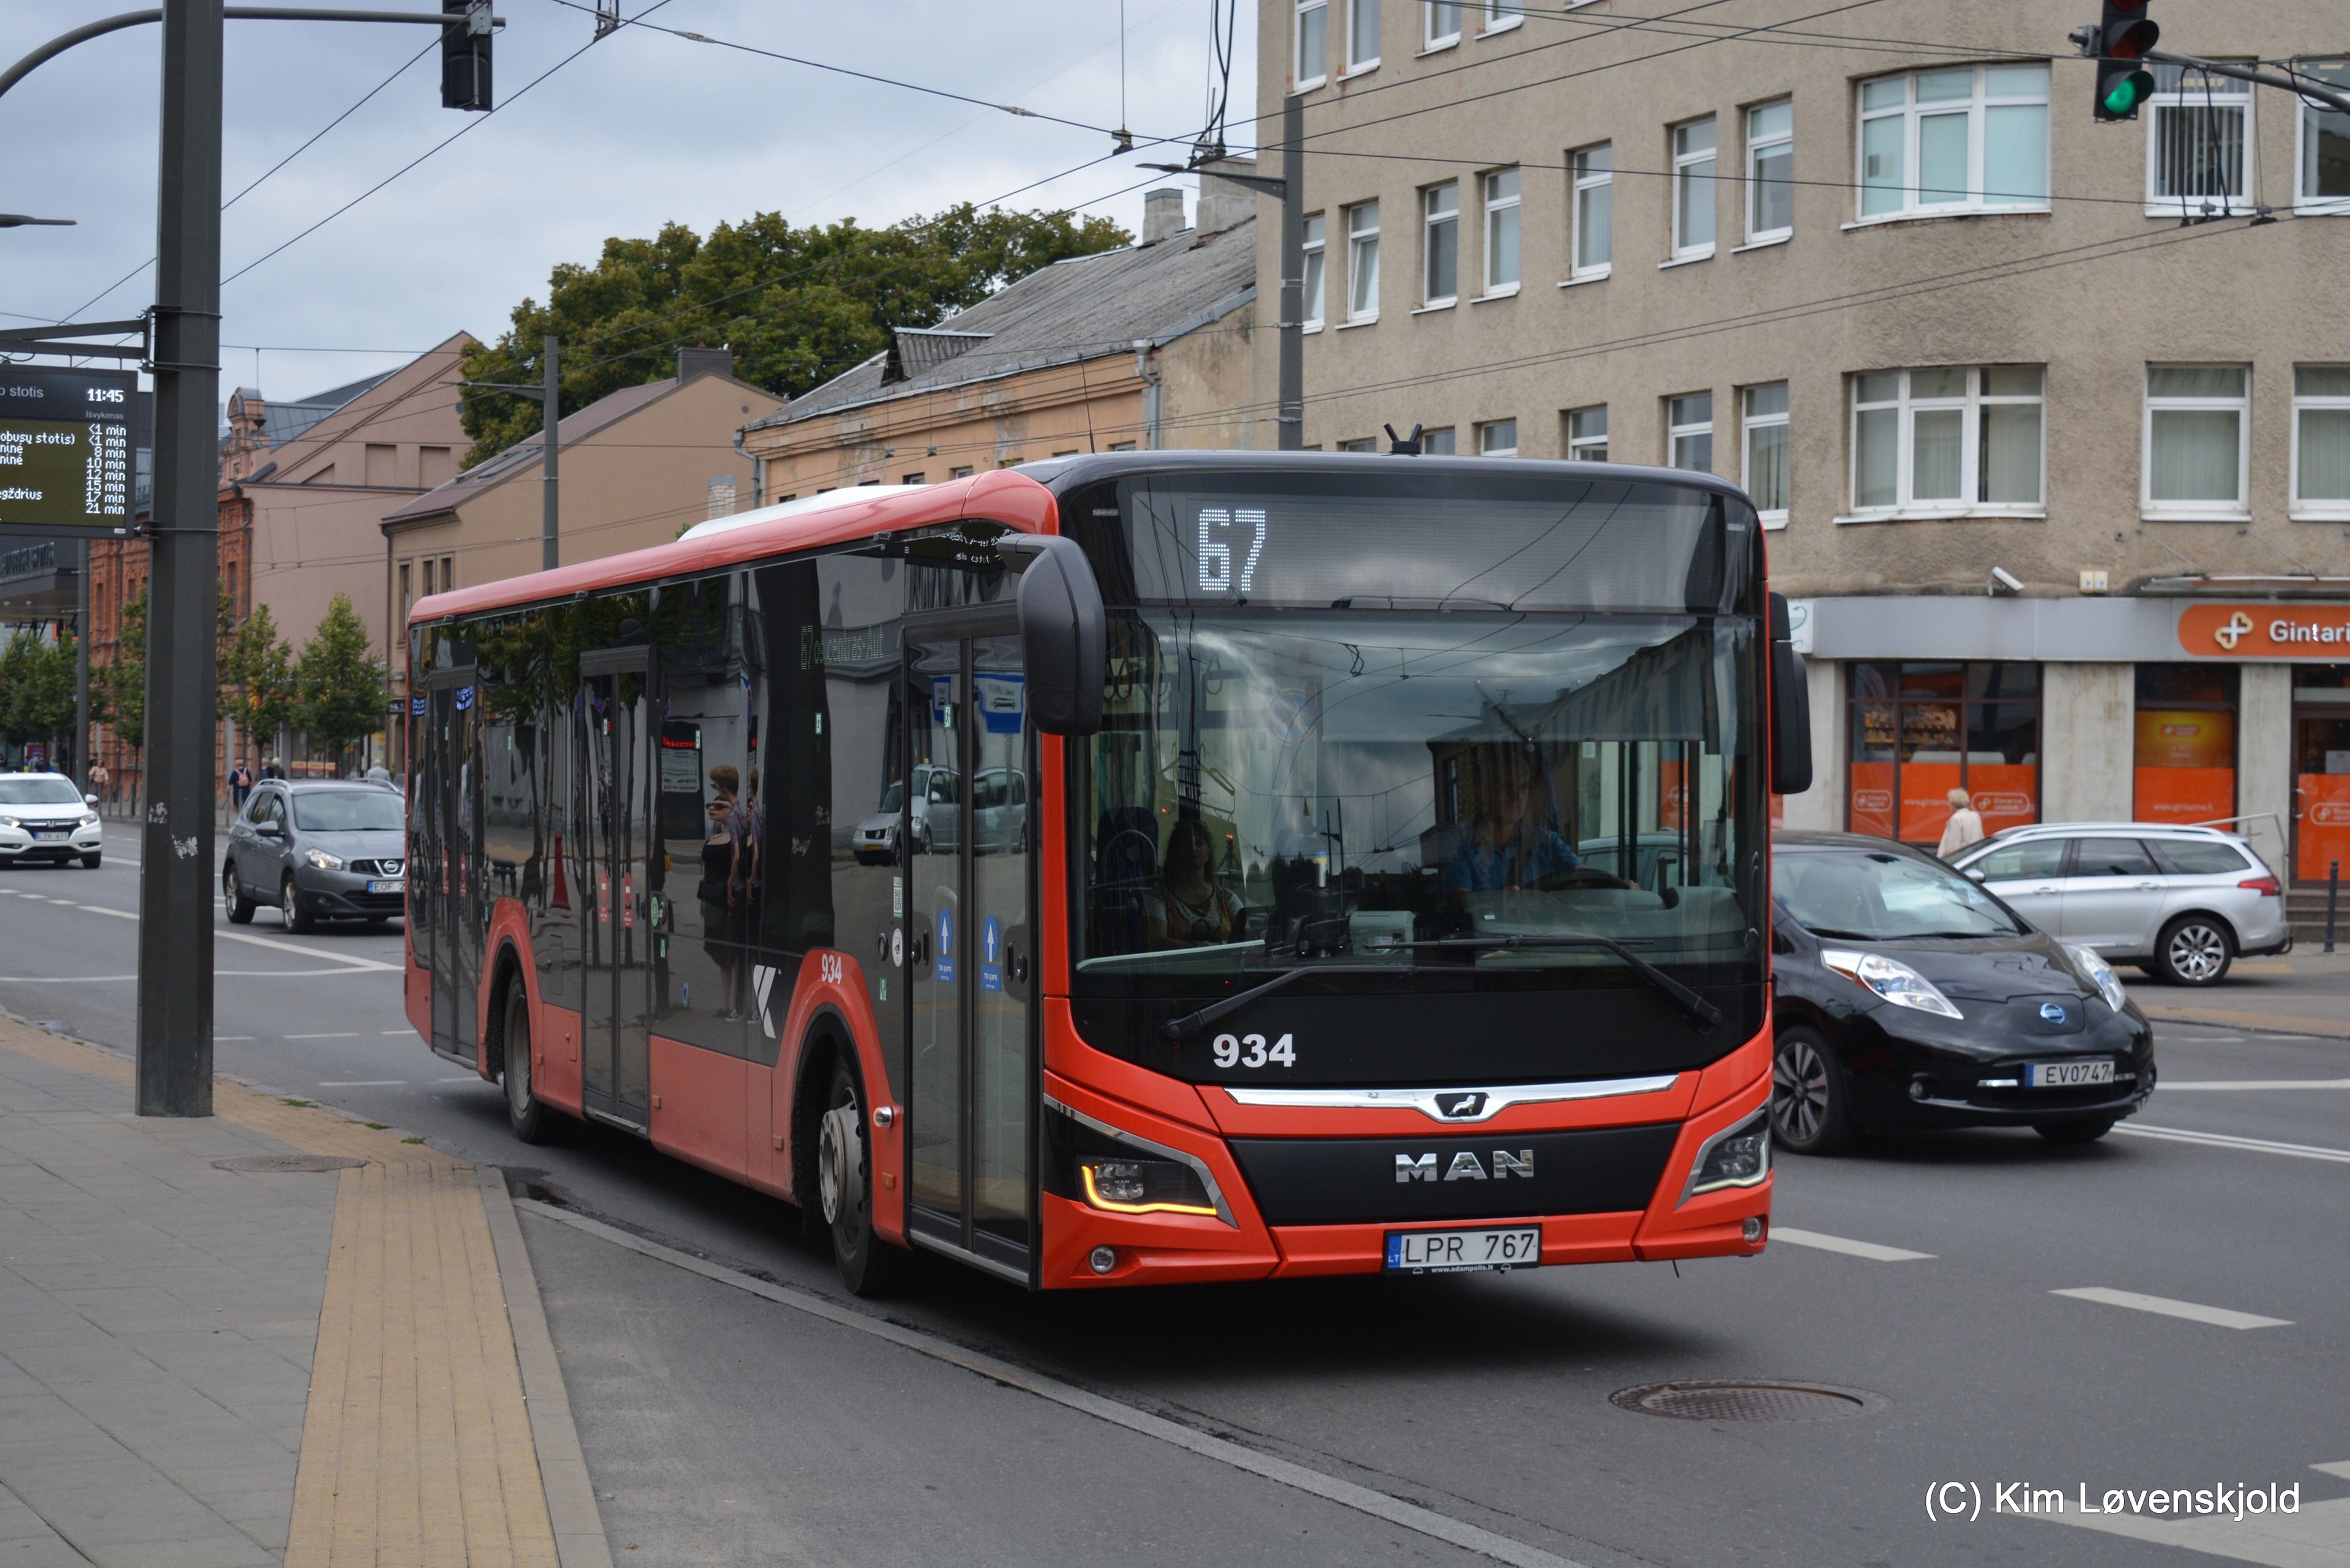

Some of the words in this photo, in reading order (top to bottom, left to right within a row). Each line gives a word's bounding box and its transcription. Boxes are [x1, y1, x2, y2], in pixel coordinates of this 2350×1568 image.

[10, 386, 43, 398] stotis
[88, 389, 124, 402] 11:45
[86, 411, 124, 420] Išvykimas
[106, 425, 126, 436] min
[35, 432, 75, 445] stotis)
[106, 436, 126, 447] min
[94, 447, 102, 457] 8
[105, 447, 126, 458] min
[87, 457, 102, 468] 10
[105, 458, 126, 469] min
[87, 469, 102, 480] 12
[105, 470, 125, 481] min
[86, 480, 102, 491] 15
[105, 481, 125, 492] min
[86, 491, 102, 502] 17
[105, 493, 125, 503] min
[86, 502, 101, 513] 21
[104, 503, 125, 515] min
[1199, 509, 1266, 591] 67
[2269, 619, 2350, 643] Gintari
[822, 954, 842, 984] 934
[1213, 1034, 1296, 1068] 934
[1395, 1149, 1534, 1182] MAN
[1405, 1236, 1464, 1263] LPR
[1485, 1233, 1535, 1261] 767
[1431, 1264, 1494, 1274] www.adampolis.lt
